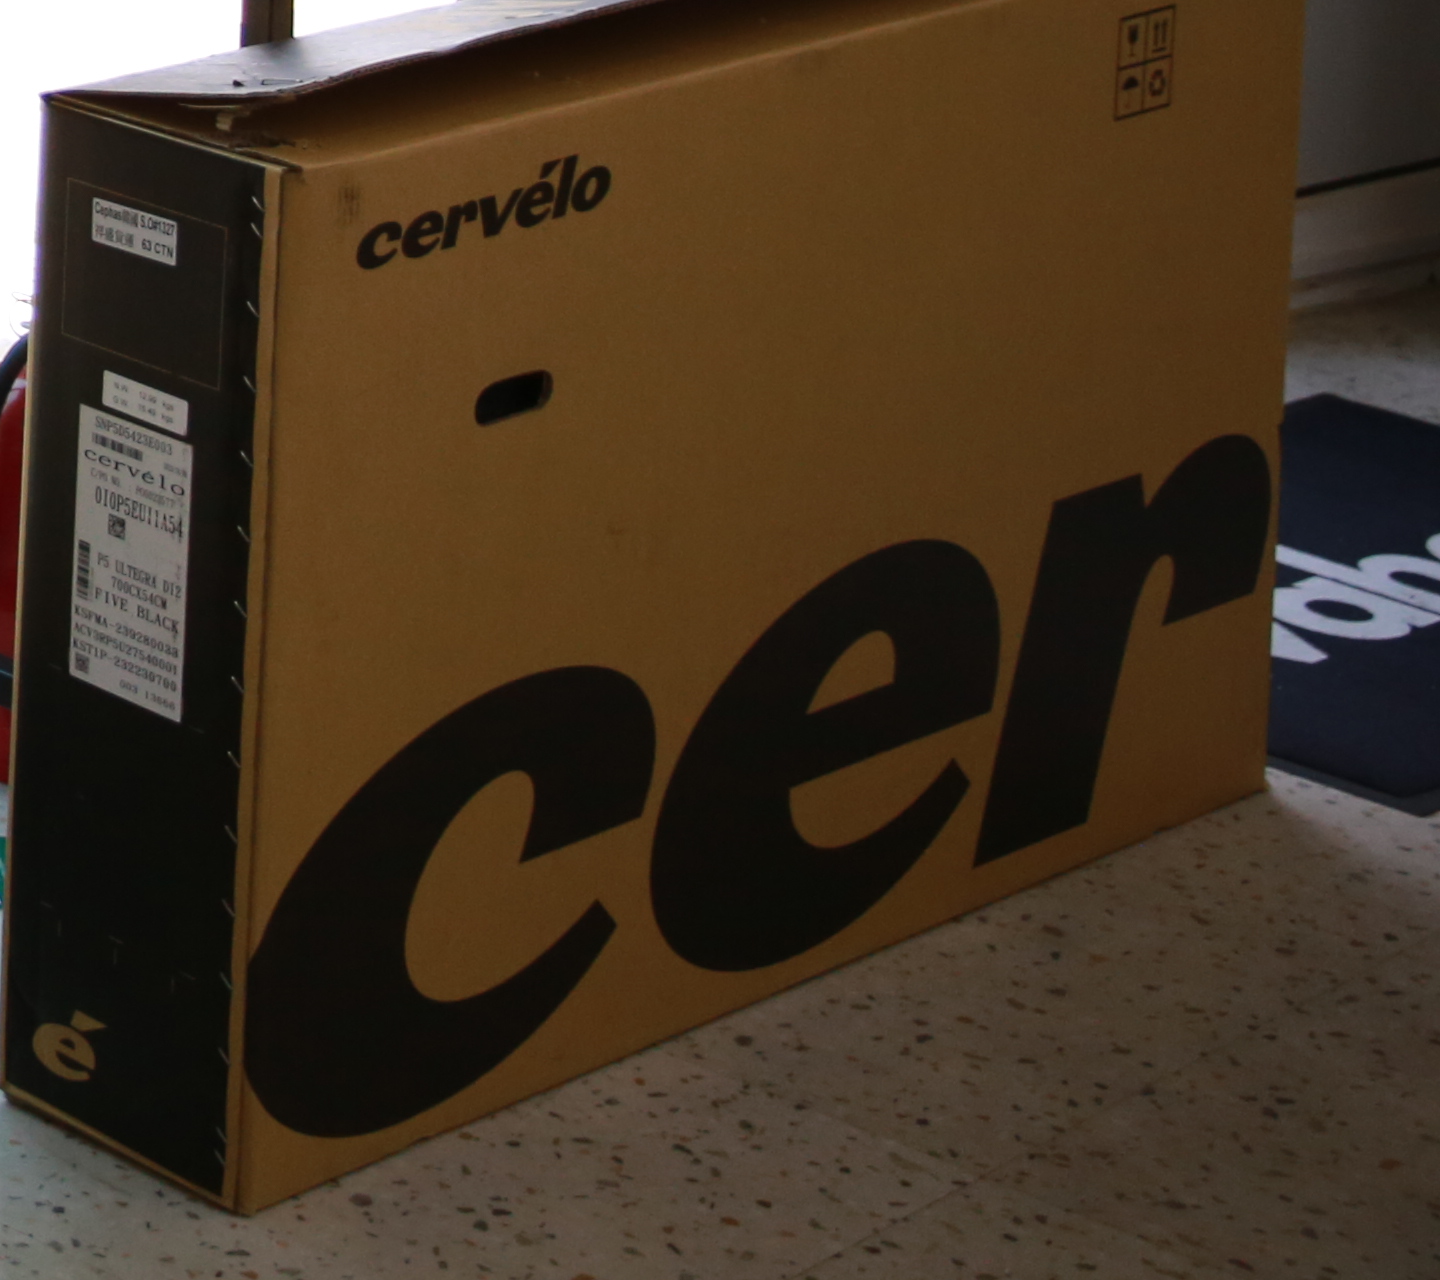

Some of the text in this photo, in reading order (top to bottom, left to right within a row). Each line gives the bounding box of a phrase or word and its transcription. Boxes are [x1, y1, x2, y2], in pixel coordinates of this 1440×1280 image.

[355, 153, 614, 273] cervélo
[141, 239, 174, 259] 63 CTN
[84, 448, 186, 497] cervélo
[97, 552, 110, 568] P5
[115, 559, 157, 589] ULTEGRA
[95, 587, 179, 636] FIVE BLACK
[245, 432, 1274, 1140] cer
[32, 1009, 108, 1083] é
